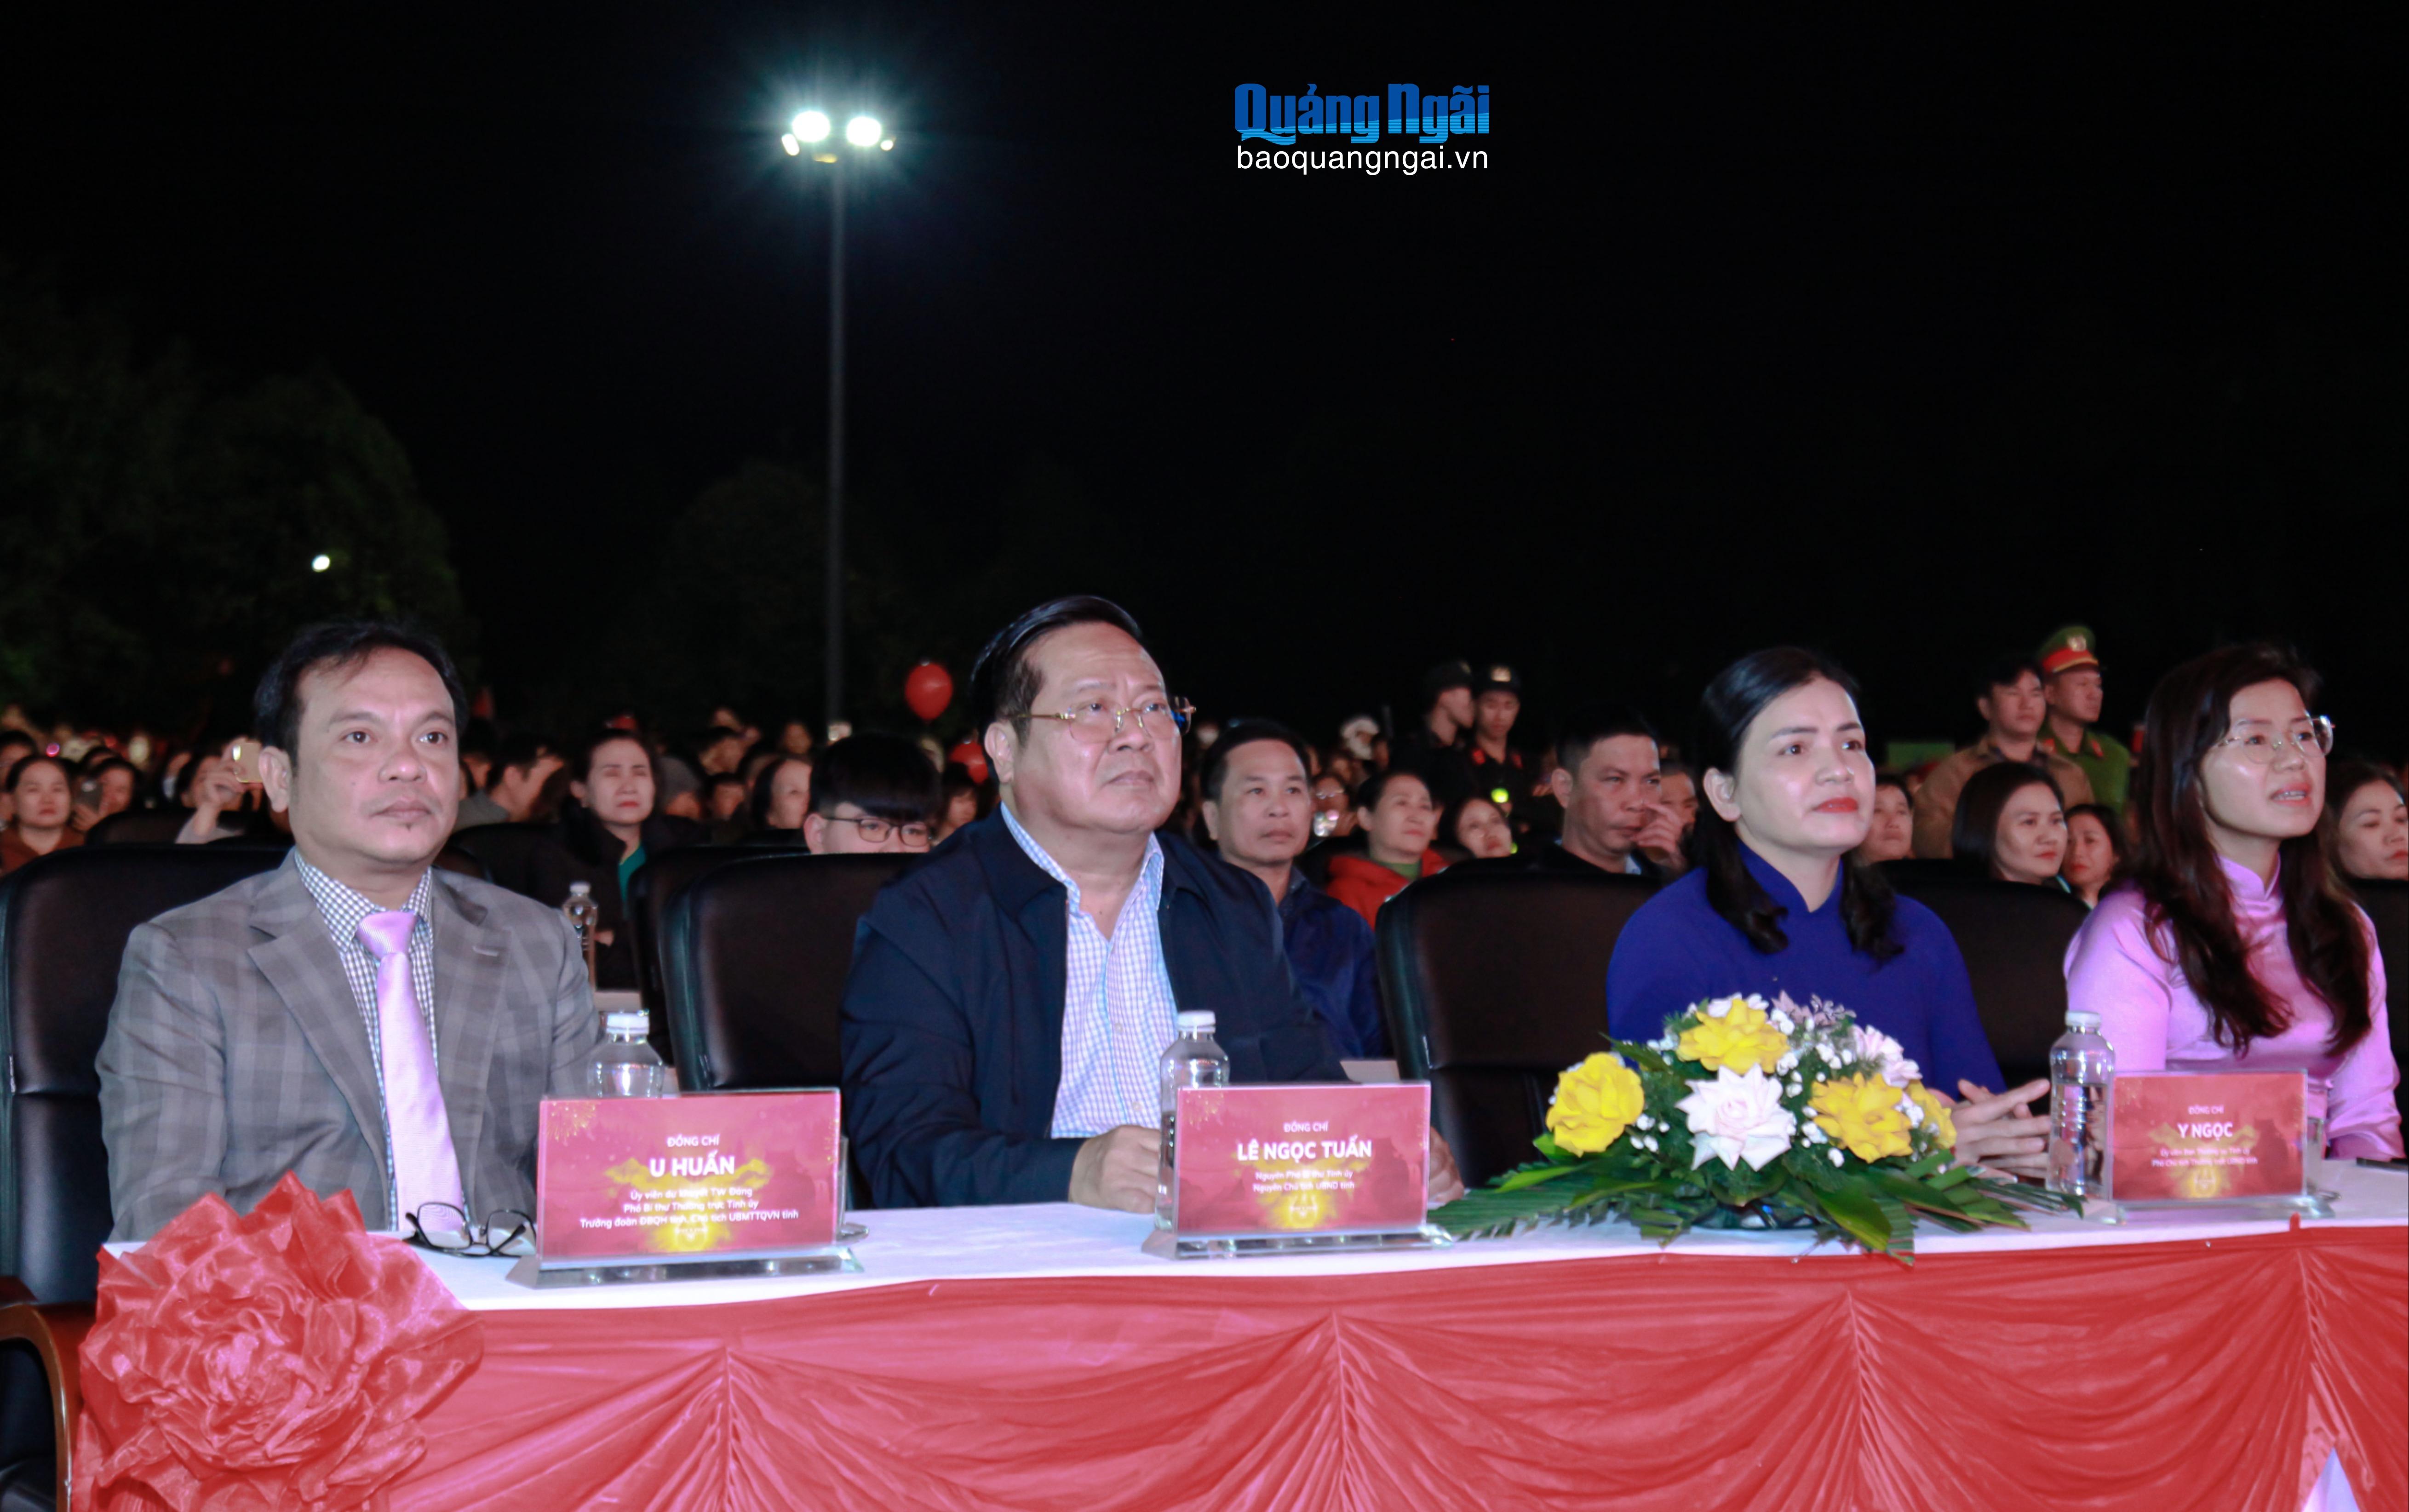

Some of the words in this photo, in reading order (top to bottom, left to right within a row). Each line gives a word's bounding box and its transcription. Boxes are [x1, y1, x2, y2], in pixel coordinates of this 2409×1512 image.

[1313, 1122, 1329, 1132] CHÍ
[2177, 1124, 2189, 1139] Y
[2191, 1122, 2233, 1141] NGỌC
[702, 1134, 721, 1146] CHÍ
[1238, 1139, 1259, 1161] LÊ
[1264, 1141, 1316, 1163] NGỌC
[1322, 1135, 1372, 1158] TUẤN
[650, 1158, 666, 1178] U
[672, 1150, 735, 1177] HUẤN
[729, 1210, 781, 1221] UBMTTQVN
